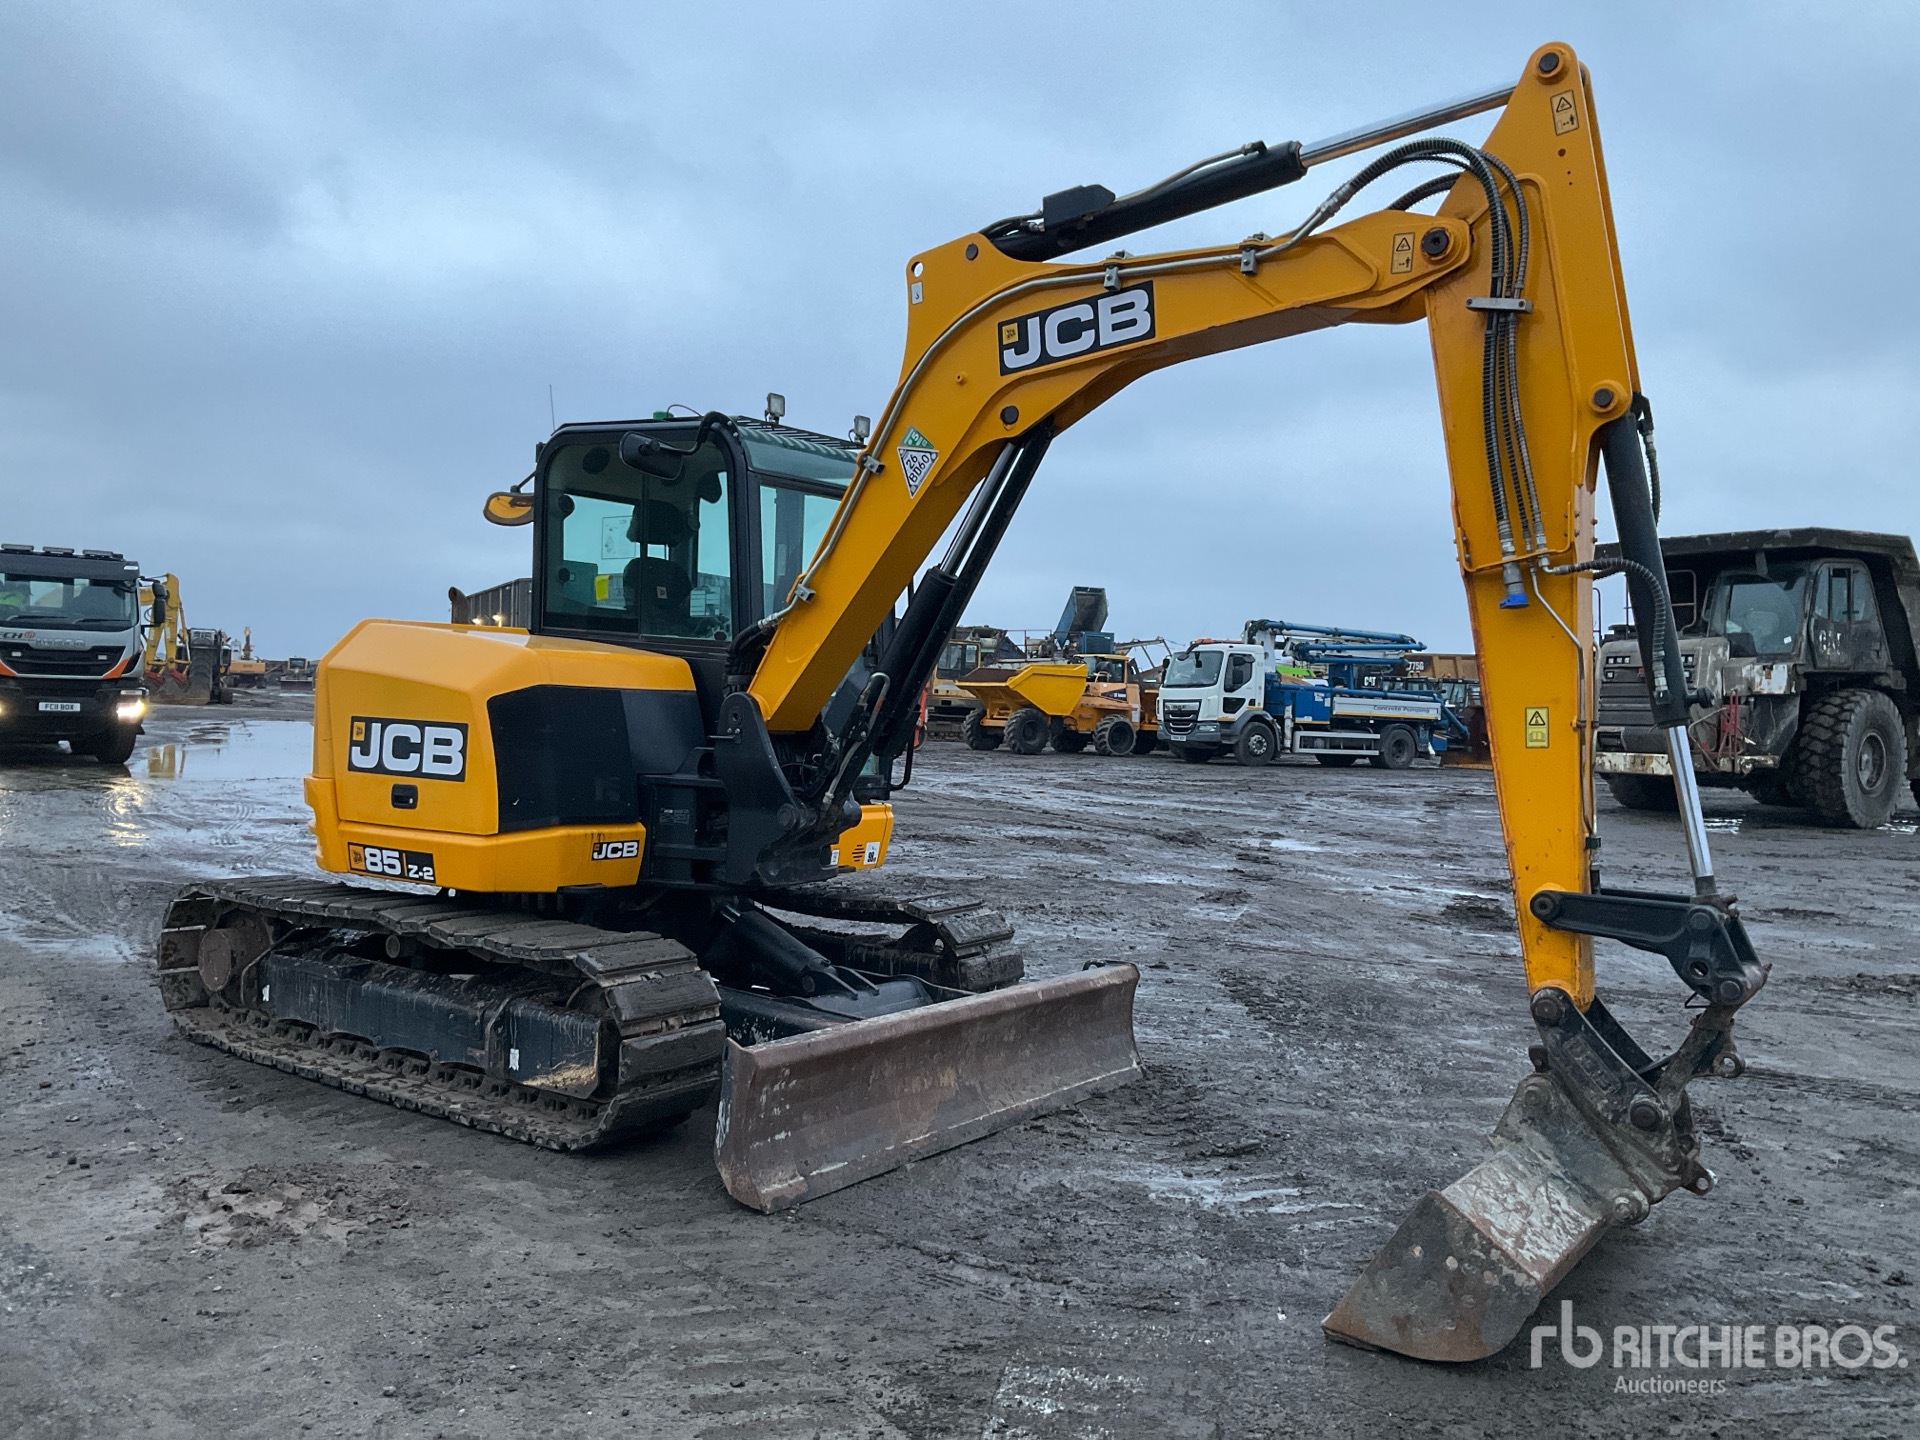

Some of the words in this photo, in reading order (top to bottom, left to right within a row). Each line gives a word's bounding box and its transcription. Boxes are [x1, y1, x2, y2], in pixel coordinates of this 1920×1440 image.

[1003, 289, 1151, 369] JCB
[905, 454, 918, 470] 26
[1374, 704, 1401, 712] Concrete
[1403, 706, 1430, 714] Pumping
[352, 723, 463, 775] JCB
[593, 842, 639, 859] JCB
[364, 847, 402, 875] 85
[407, 864, 434, 881] Z-2
